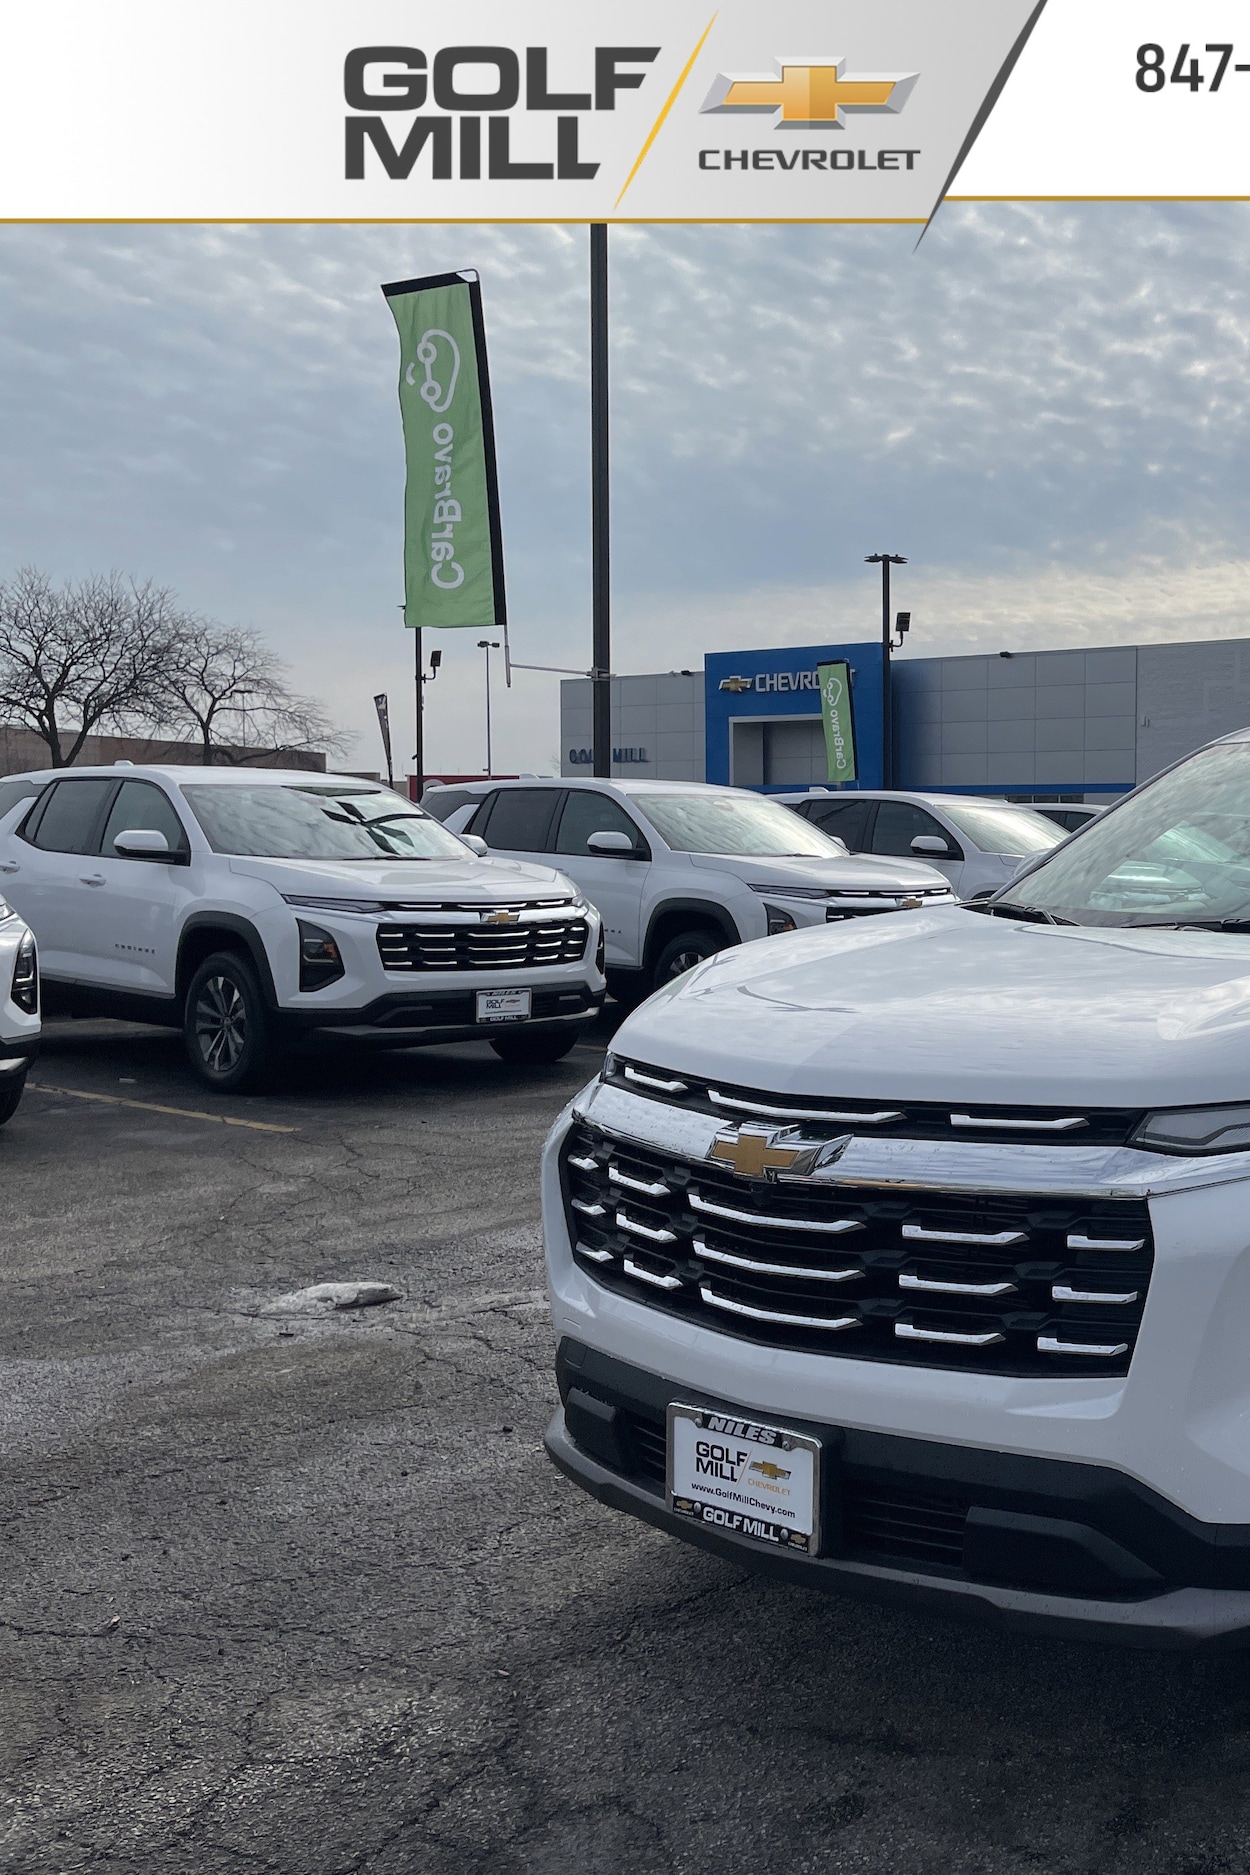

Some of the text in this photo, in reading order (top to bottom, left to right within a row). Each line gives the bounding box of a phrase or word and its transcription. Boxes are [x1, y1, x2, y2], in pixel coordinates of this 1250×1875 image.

[755, 668, 856, 693] CHEVROT
[569, 748, 595, 765] GOL
[707, 1416, 777, 1445] NILES
[696, 1441, 748, 1467] GOLF
[696, 1457, 738, 1483] MILL
[747, 1478, 791, 1496] CHEVROLET
[691, 1482, 796, 1519] www.GolfMillChevy.com
[702, 1506, 742, 1530] GOLF
[742, 1518, 780, 1543] MILL
